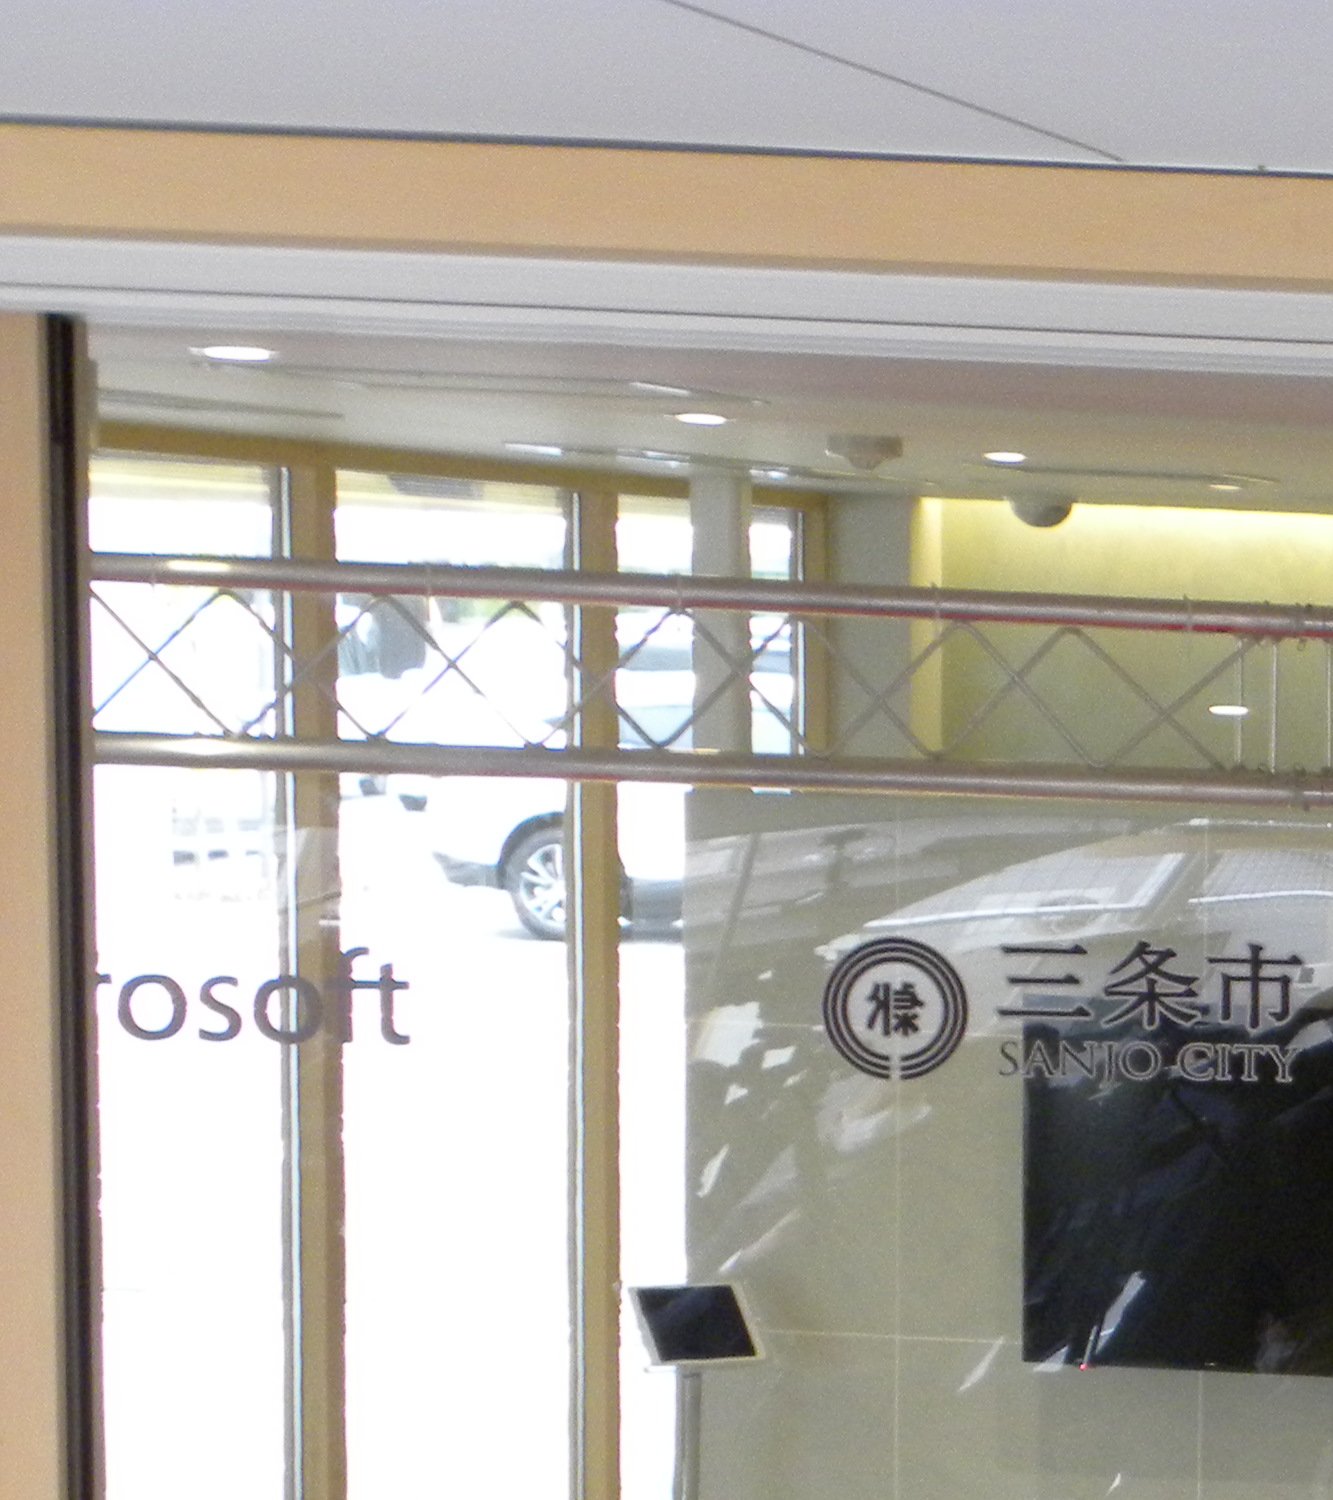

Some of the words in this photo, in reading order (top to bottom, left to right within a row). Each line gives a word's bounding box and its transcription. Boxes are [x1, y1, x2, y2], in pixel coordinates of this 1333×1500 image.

[996, 940, 1303, 1030] 三条市
[998, 1041, 1162, 1081] SANJO
[1177, 1042, 1301, 1083] CITY
